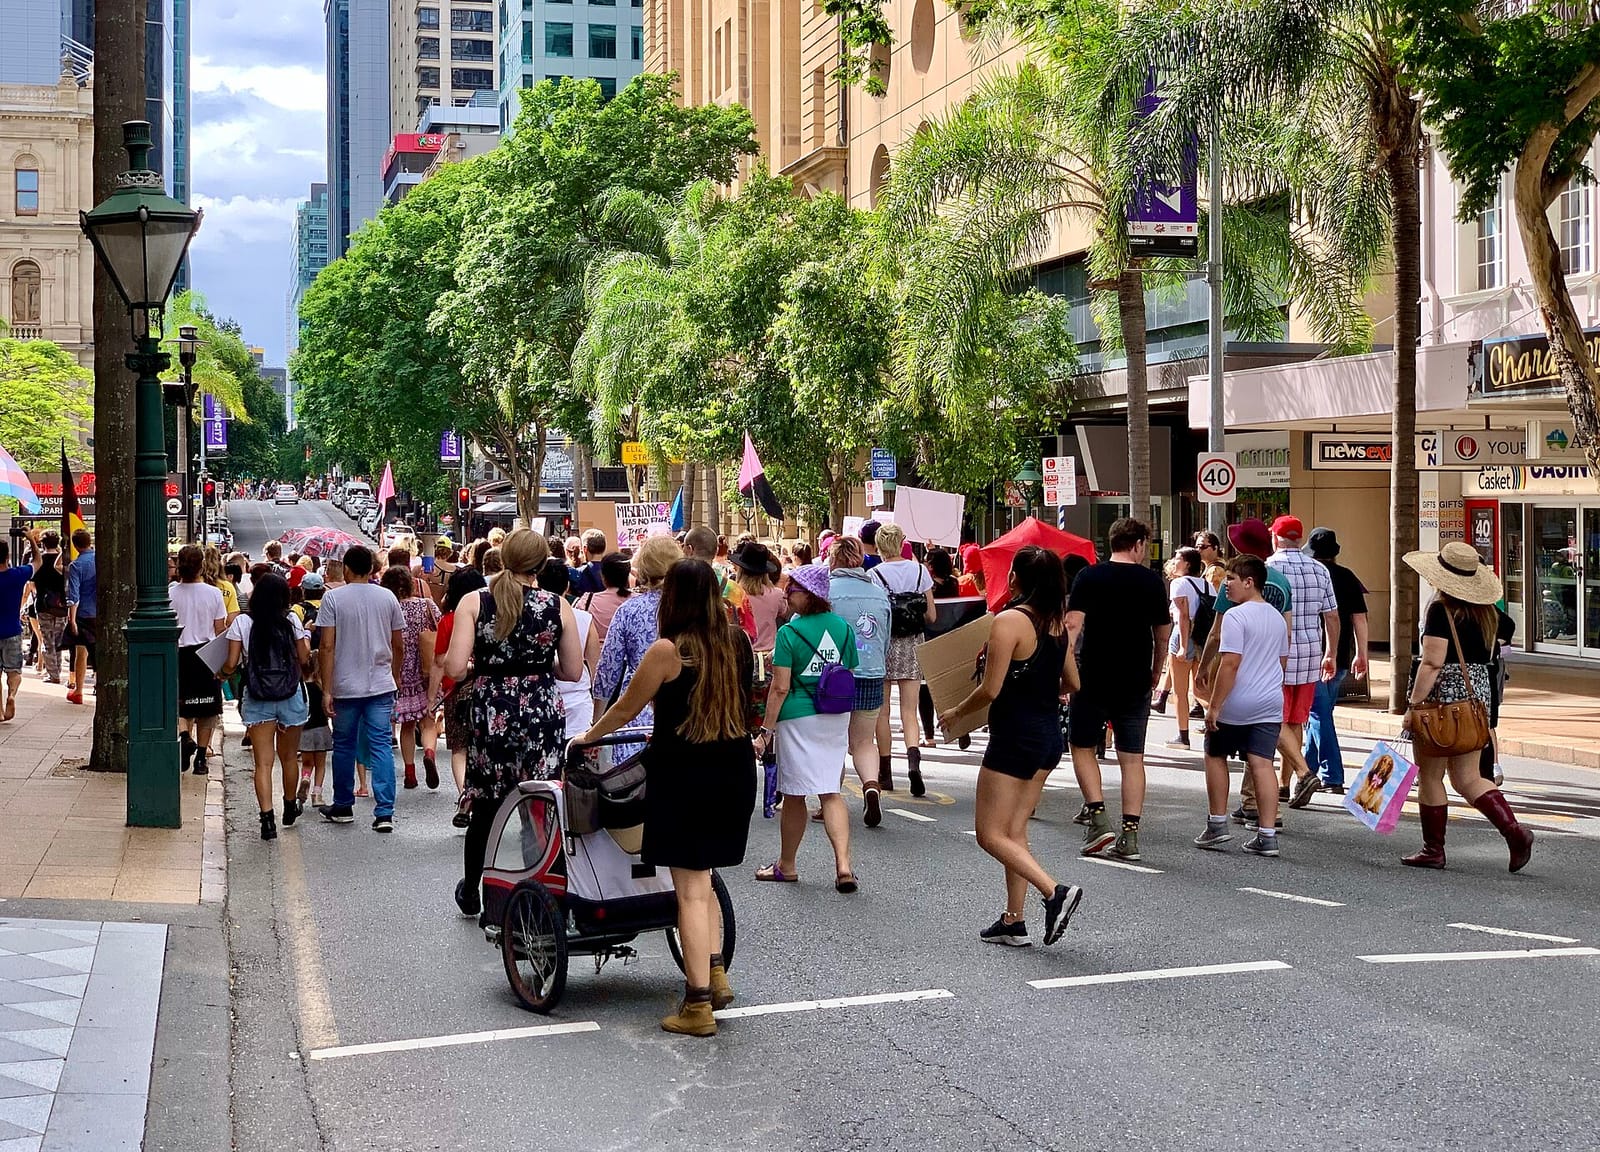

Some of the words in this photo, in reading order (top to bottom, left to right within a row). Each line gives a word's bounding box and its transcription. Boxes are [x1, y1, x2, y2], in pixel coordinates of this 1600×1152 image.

[1203, 467, 1230, 486] 40
[1478, 472, 1511, 490] Casket
[1422, 501, 1436, 509] GIFTS
[1439, 500, 1464, 509] GIFTS
[616, 504, 658, 519] MISOGYNY
[1440, 510, 1464, 518] GIFTS
[622, 518, 636, 527] HAS
[638, 517, 649, 526] NO
[1420, 521, 1438, 529] DRINKS
[1440, 520, 1464, 529] GIFTS
[1440, 530, 1464, 539] GIFTS
[820, 648, 835, 660] THE
